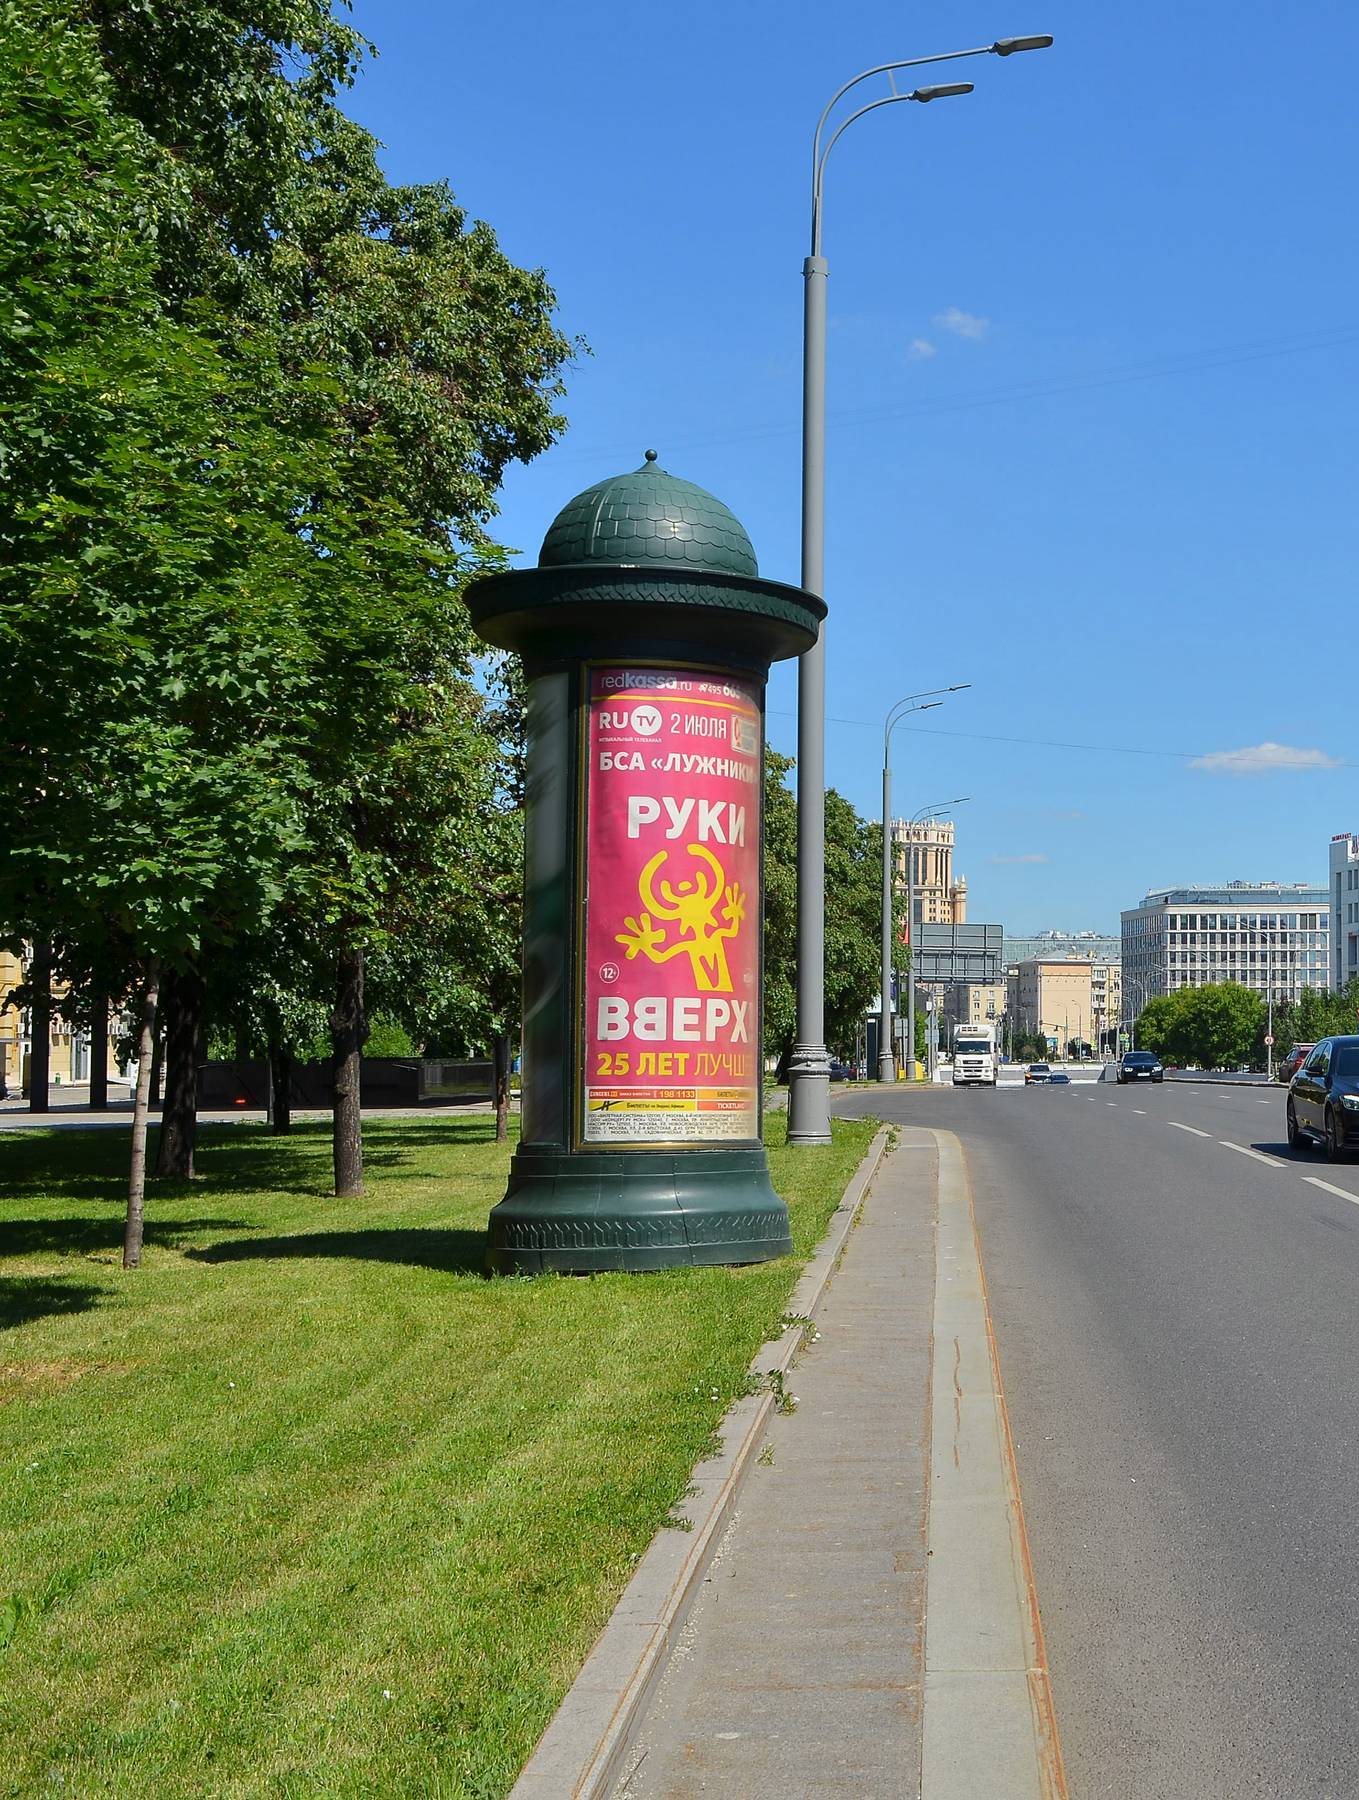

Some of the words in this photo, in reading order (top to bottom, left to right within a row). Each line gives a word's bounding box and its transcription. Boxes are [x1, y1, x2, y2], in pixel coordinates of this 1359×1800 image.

[600, 672, 692, 692] redkassa.ru
[599, 710, 629, 730] RU
[636, 714, 657, 727] TV
[670, 713, 681, 735] 2
[684, 714, 727, 739] ИЮЛЯ
[600, 751, 646, 772] БСА
[627, 795, 746, 848] РУКИ
[602, 966, 618, 980] 12+
[596, 1052, 630, 1077] 25
[636, 1052, 689, 1077] ЛЕТ
[694, 1053, 753, 1078] ЛУЧШ
